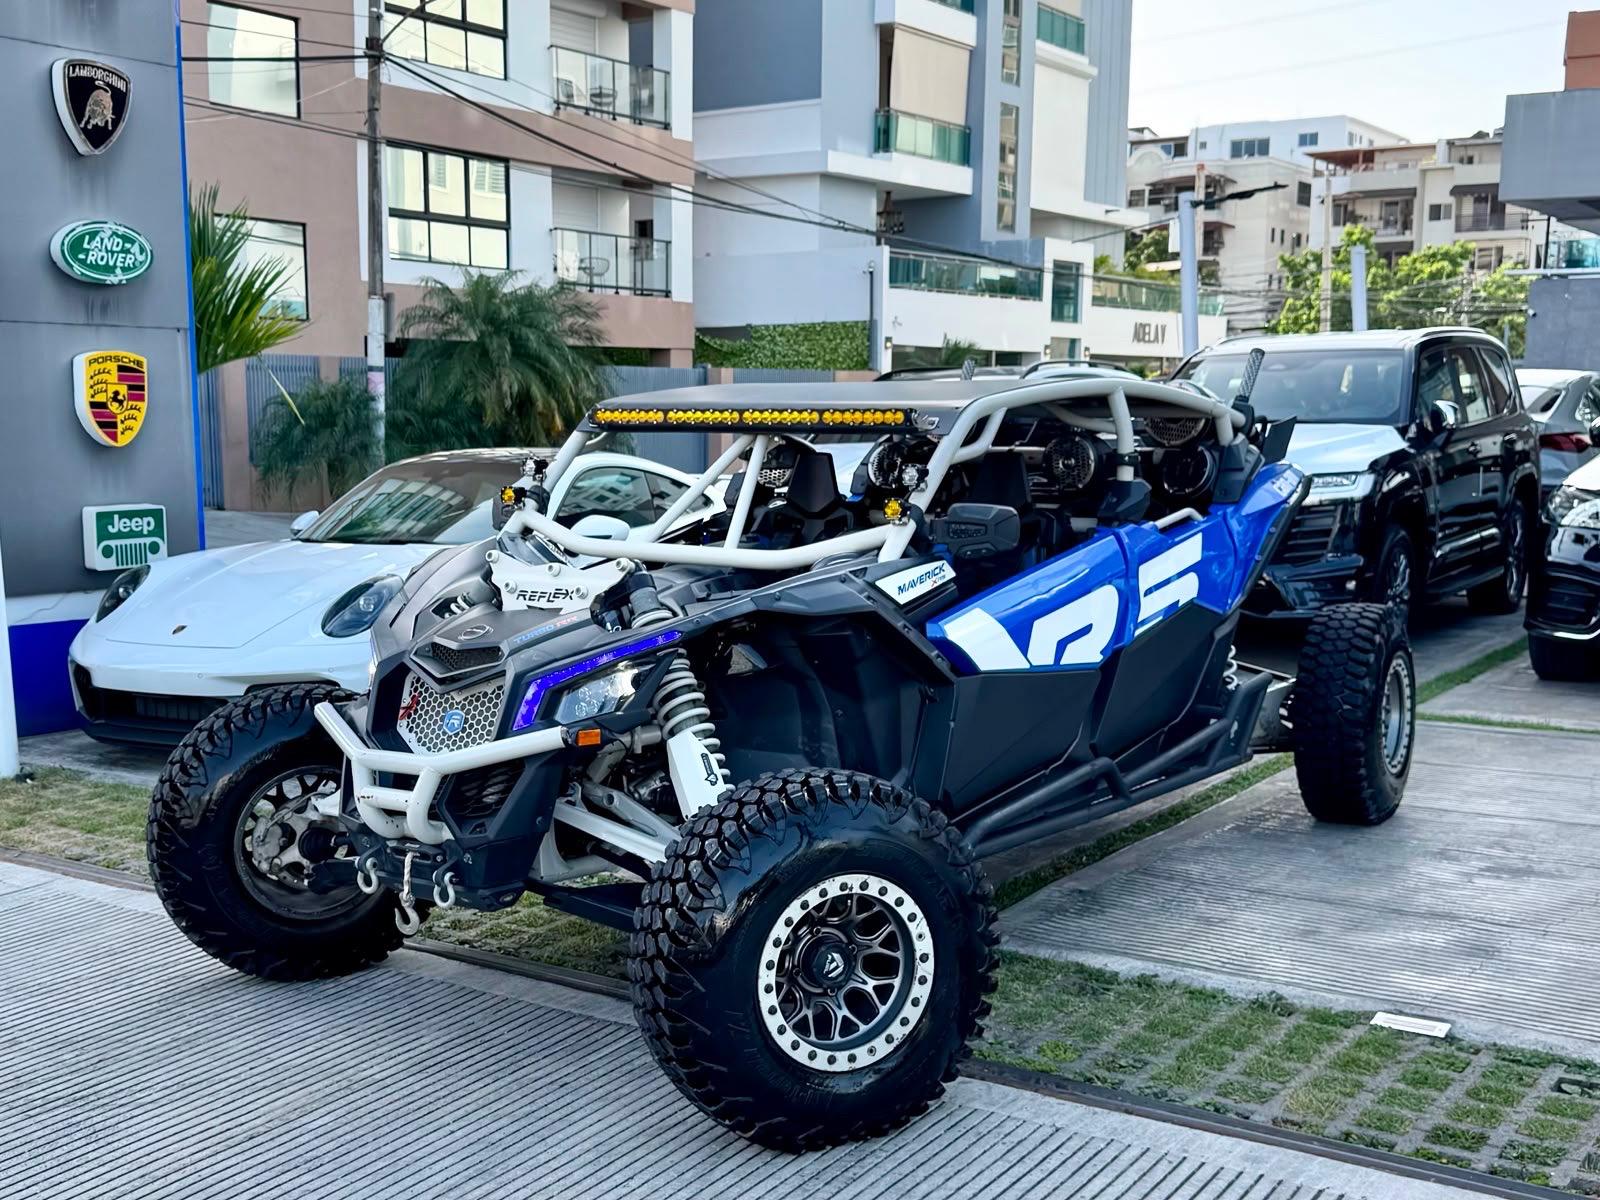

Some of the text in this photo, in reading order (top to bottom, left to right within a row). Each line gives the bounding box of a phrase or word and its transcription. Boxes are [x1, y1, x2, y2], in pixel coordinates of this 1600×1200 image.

[69, 65, 127, 93] LAMBORGHINI
[88, 355, 144, 370] PORSCHE
[106, 513, 156, 535] Jeep
[897, 562, 946, 596] MAVERICK
[515, 587, 575, 604] REFLEX
[513, 623, 555, 645] TURBO
